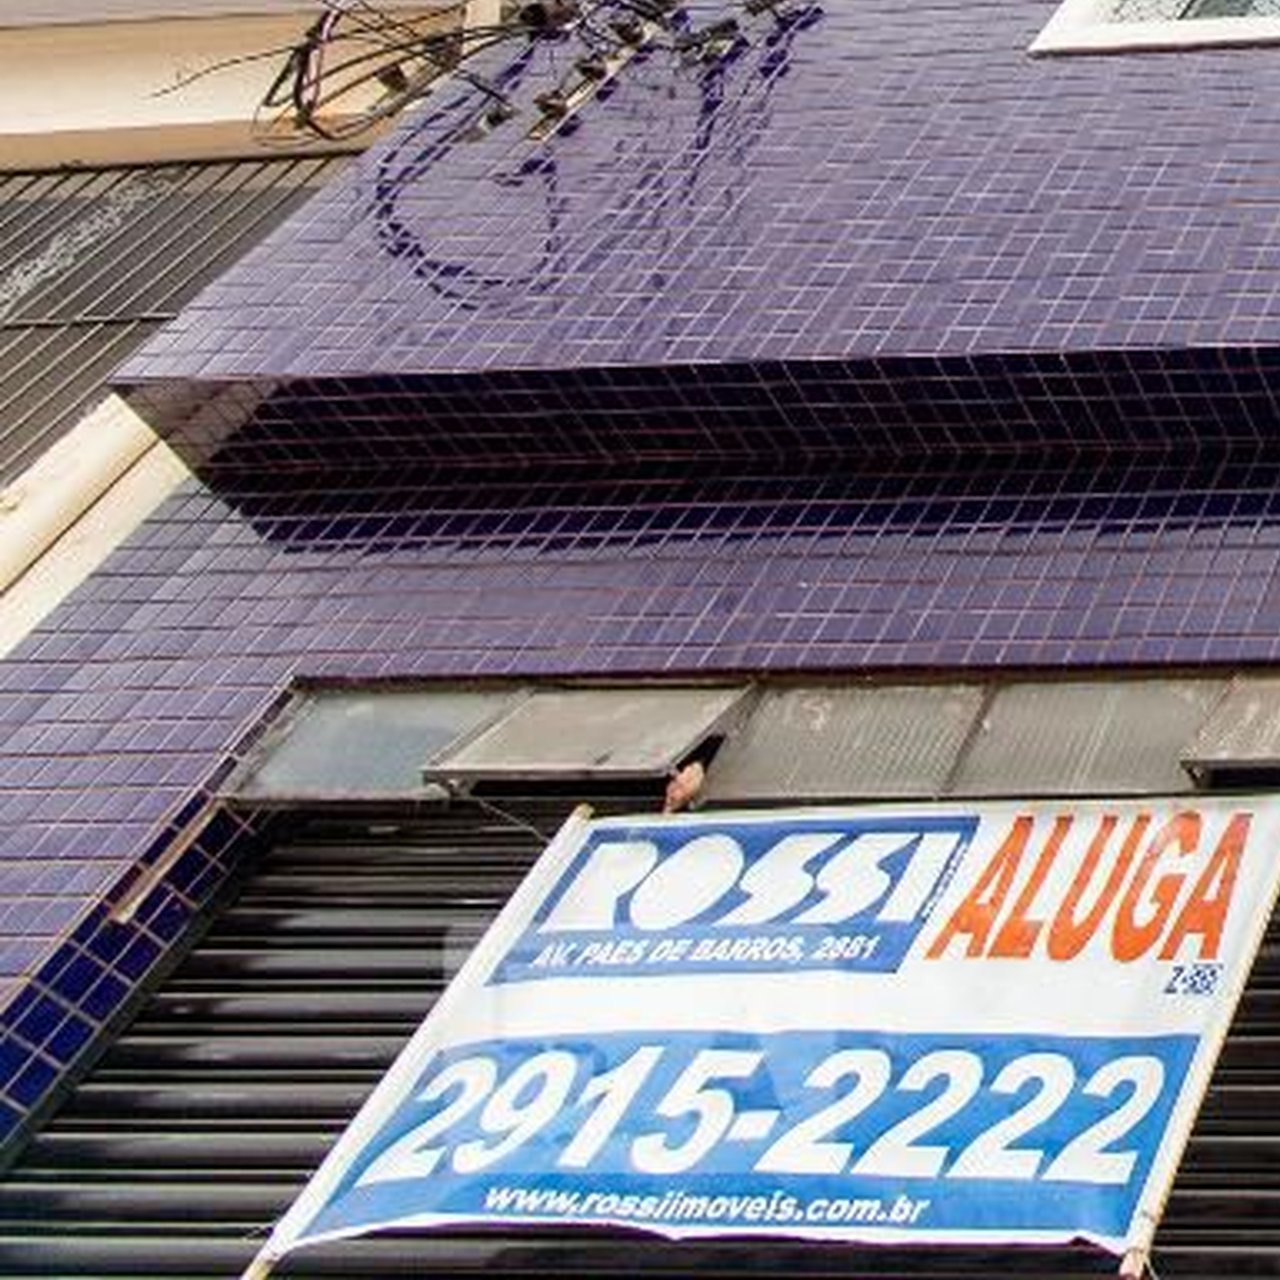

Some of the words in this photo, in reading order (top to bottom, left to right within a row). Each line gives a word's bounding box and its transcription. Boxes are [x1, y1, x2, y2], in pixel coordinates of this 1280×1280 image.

[536, 832, 962, 931] ROSSI
[924, 810, 1253, 962] ALUGA
[575, 939, 650, 966] PAES
[649, 937, 694, 962] DE
[356, 1043, 1166, 1185] 2915-2222
[484, 1184, 930, 1223] www.rossiimoveis.com.br
